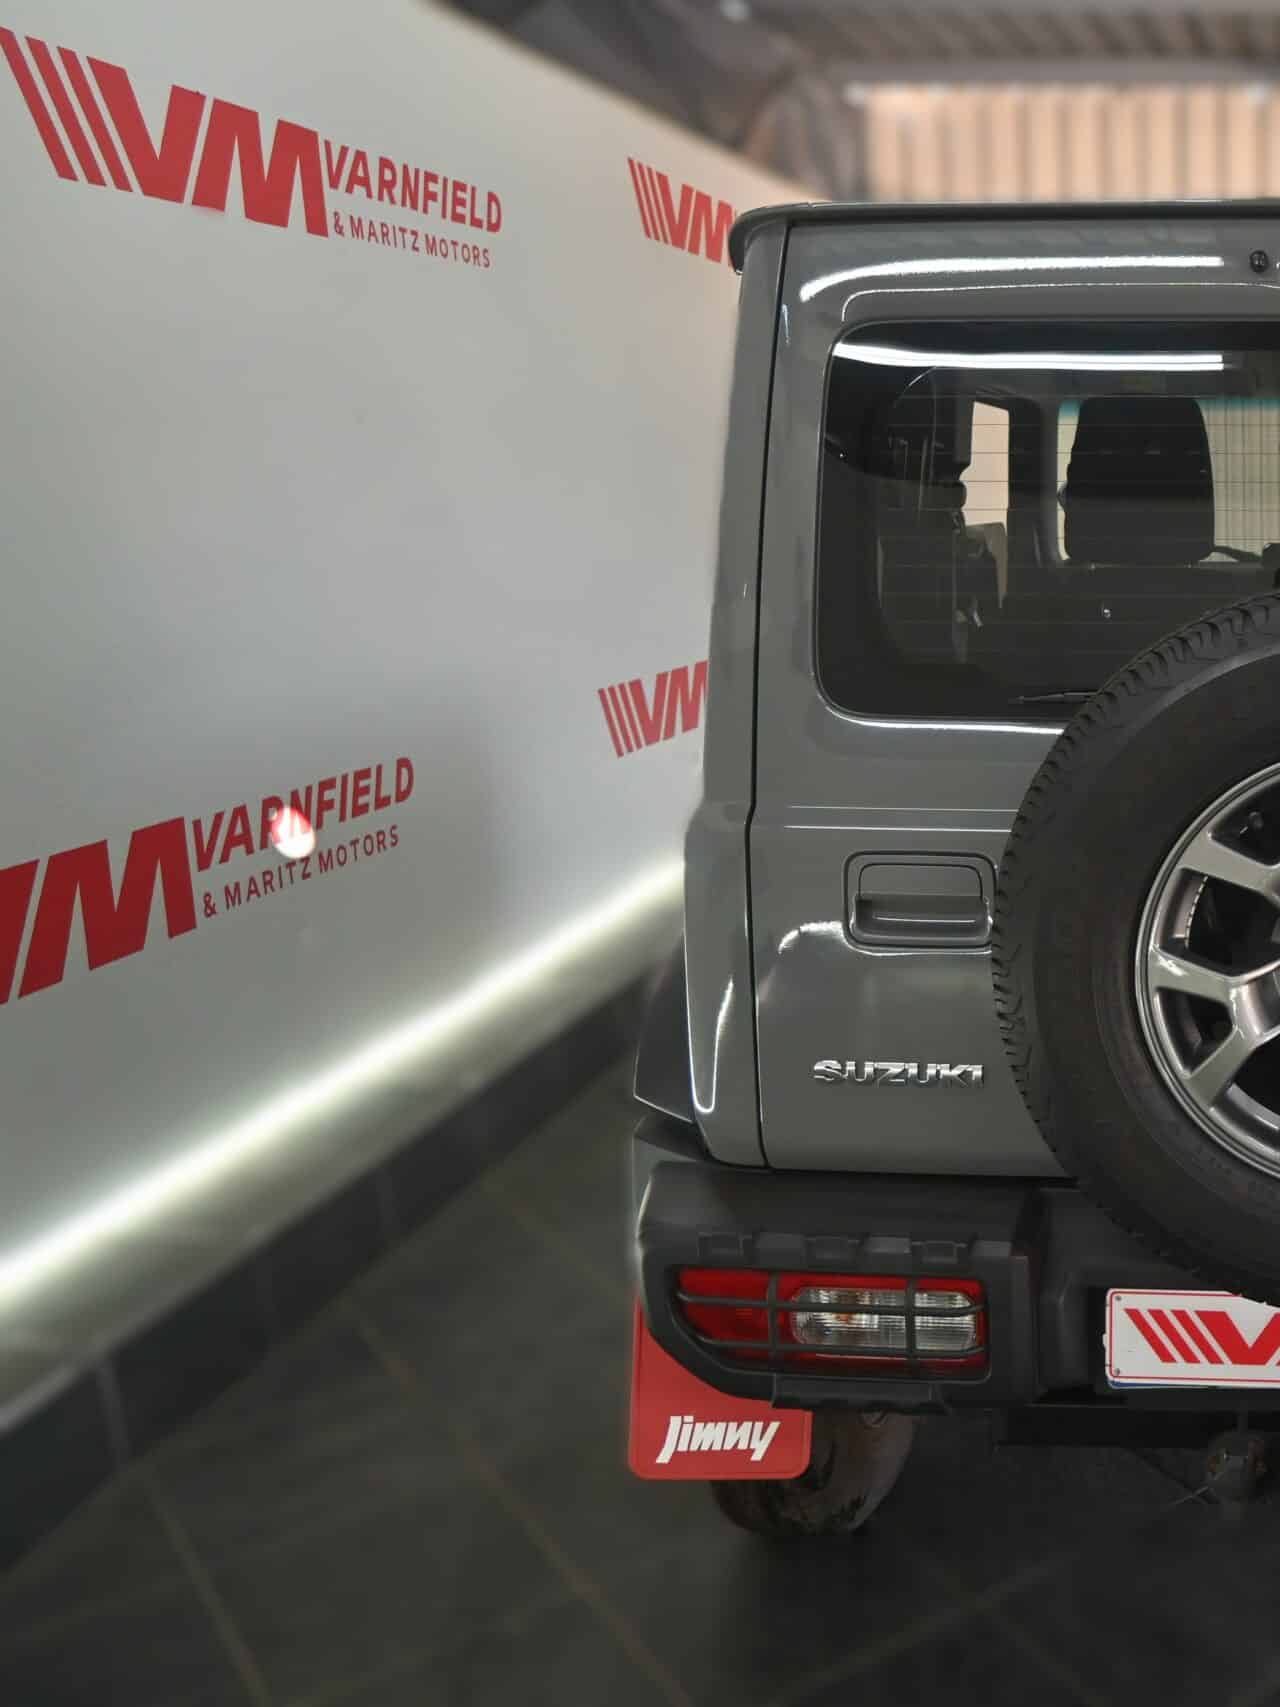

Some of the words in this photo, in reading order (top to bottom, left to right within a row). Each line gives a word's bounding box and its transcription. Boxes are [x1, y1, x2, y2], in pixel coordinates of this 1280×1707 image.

[324, 139, 502, 233] VARNFIELD
[333, 211, 345, 238] &
[349, 214, 420, 253] MARITZ
[424, 233, 491, 268] MOTORS
[203, 892, 217, 918] &
[224, 857, 312, 911] MARITZ
[318, 825, 398, 875] MOTORS
[814, 1059, 983, 1087] SUZUKI
[655, 1415, 781, 1464] Jimny
